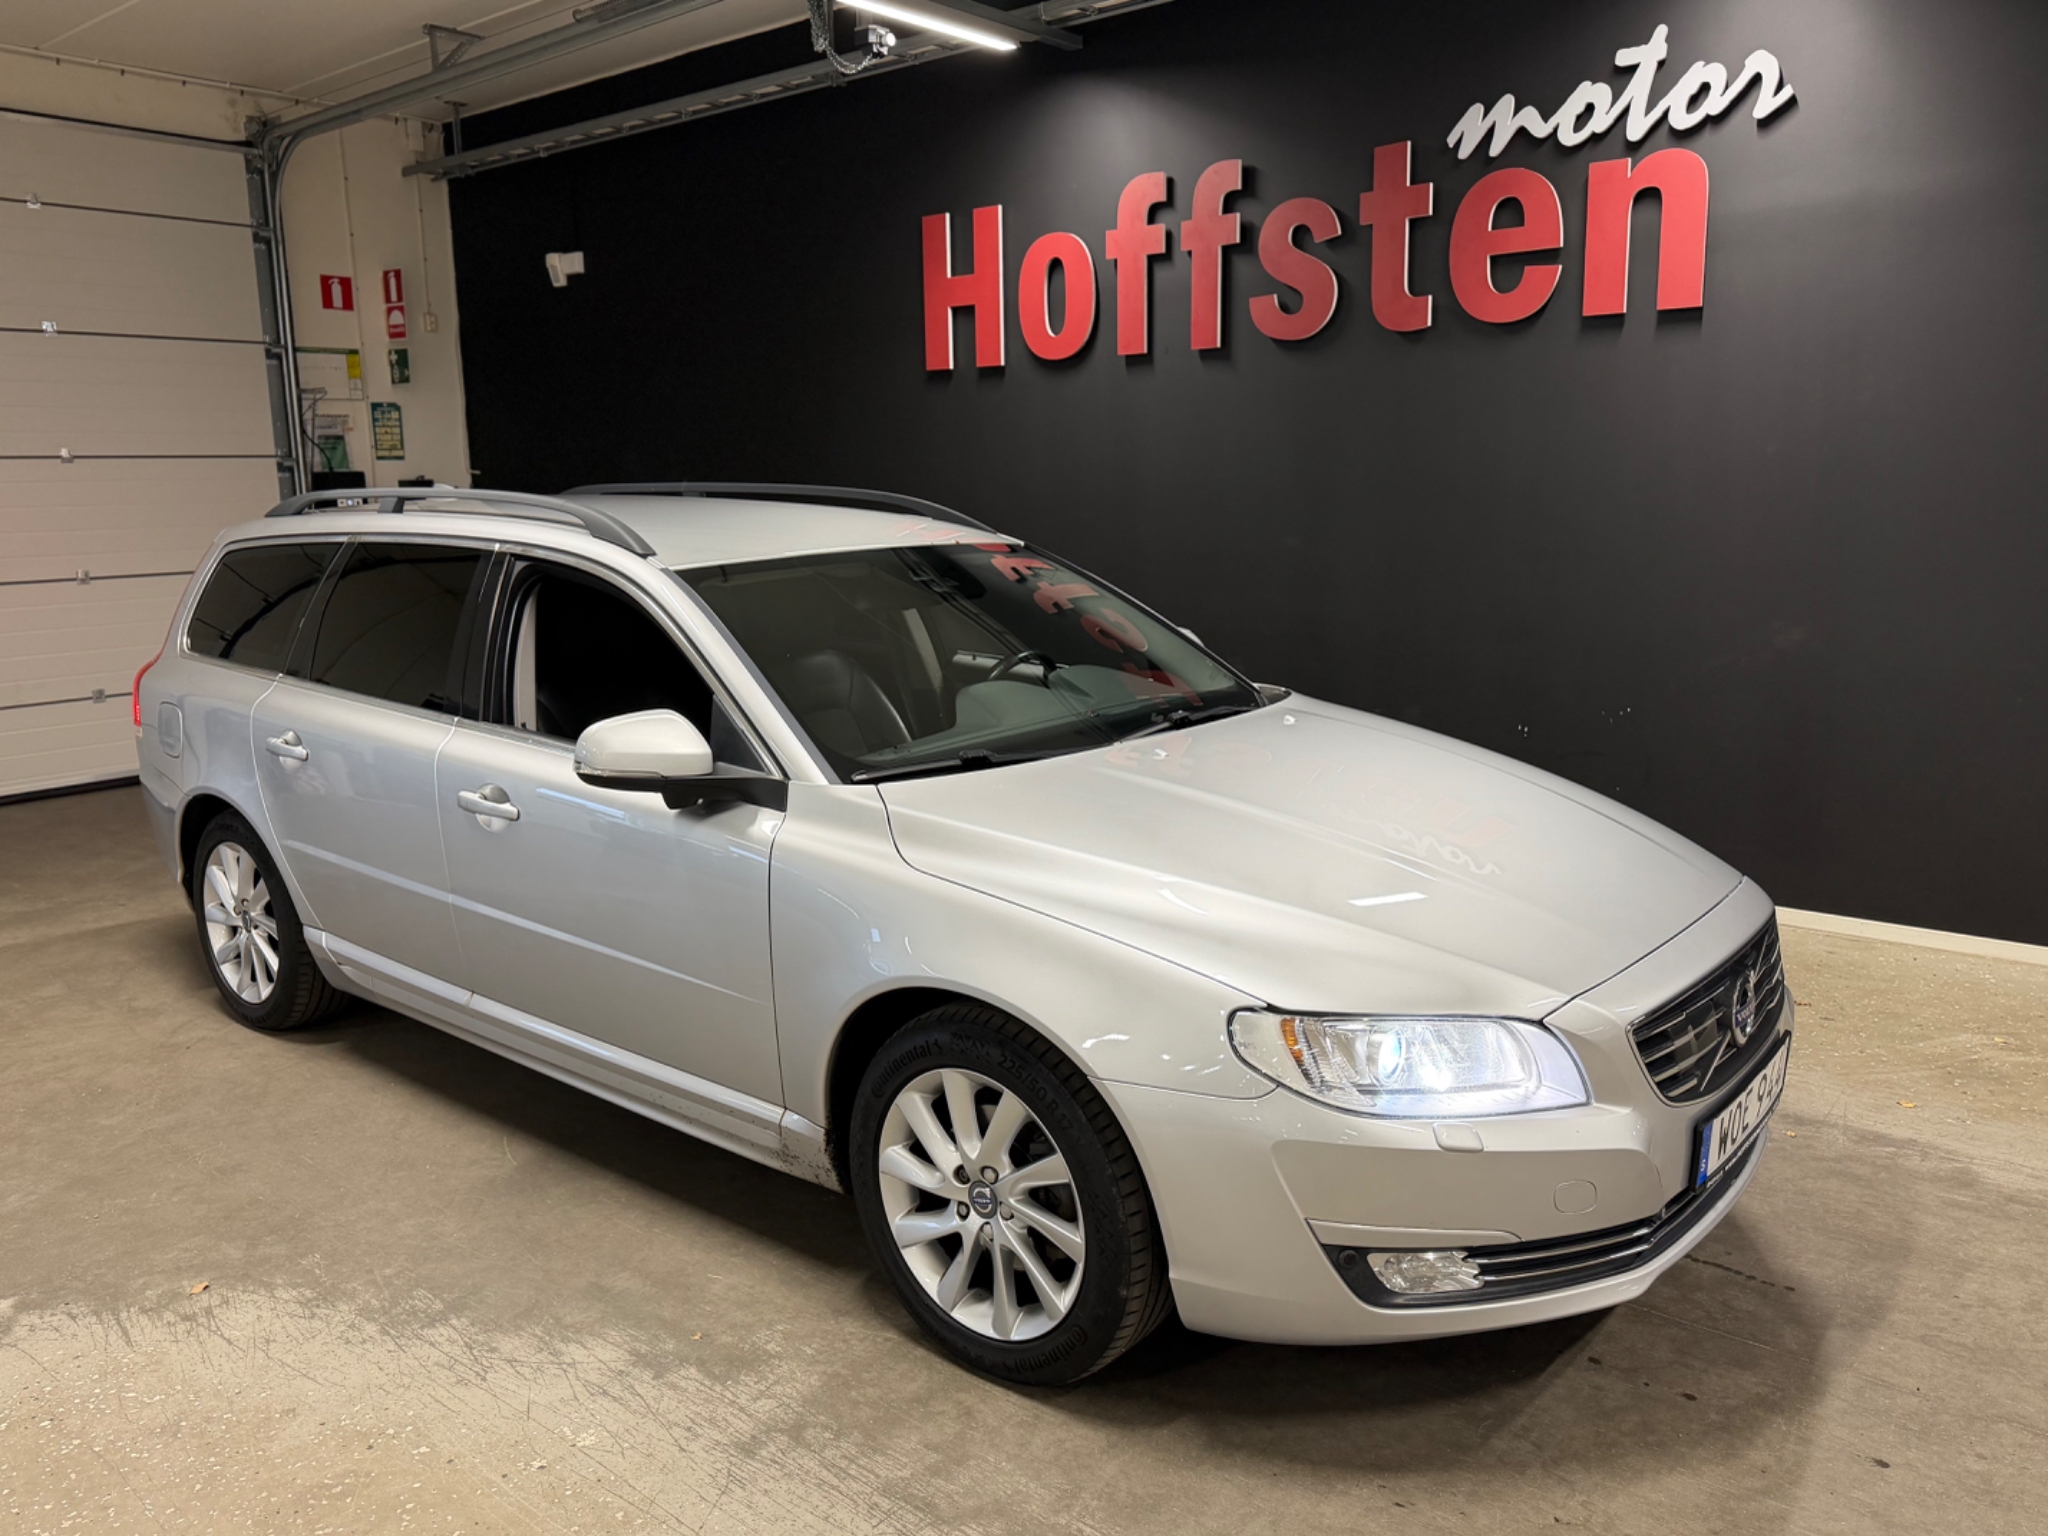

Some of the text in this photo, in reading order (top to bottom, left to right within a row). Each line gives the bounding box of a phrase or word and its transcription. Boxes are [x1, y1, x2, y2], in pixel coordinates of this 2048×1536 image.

[1447, 24, 1797, 159] motor
[921, 140, 1711, 372] Hoffsten
[871, 1040, 932, 1099] Continental
[998, 1053, 1048, 1100] 225/50
[1717, 1086, 1753, 1160] WOE
[1014, 1324, 1088, 1374] Continental
